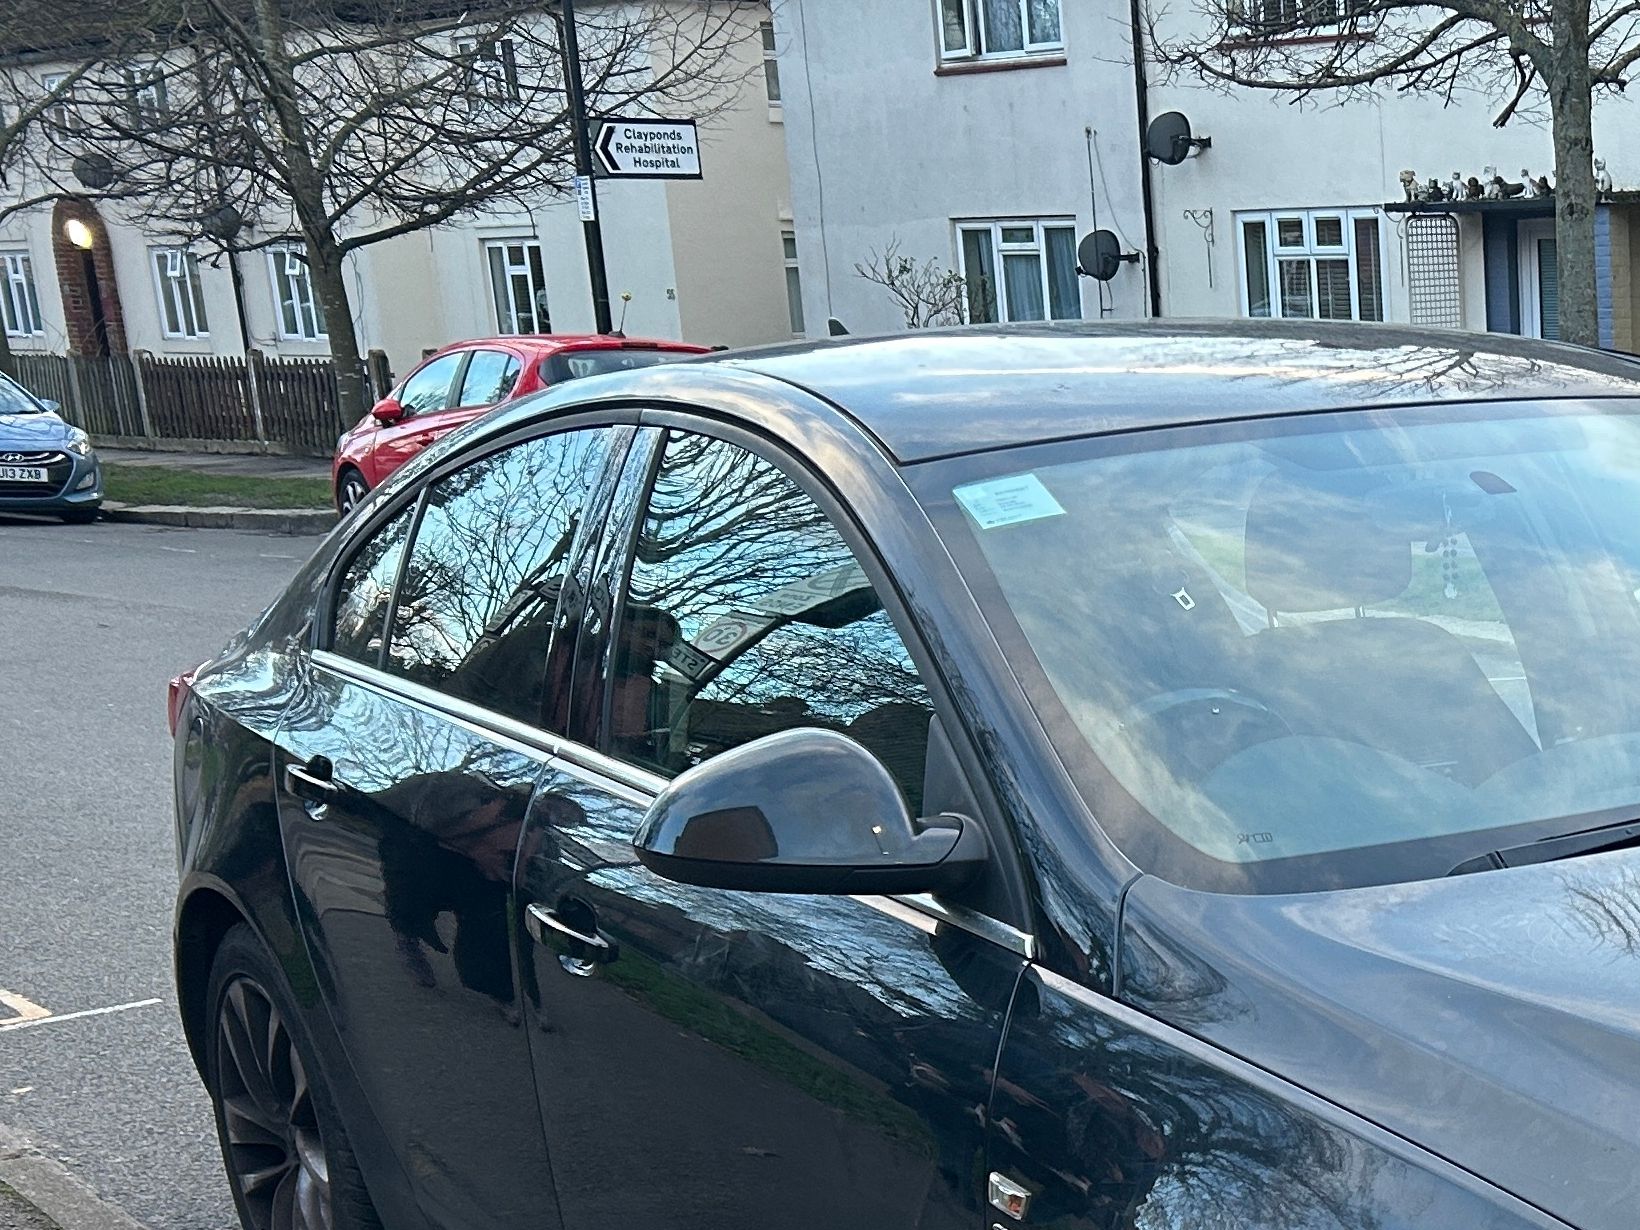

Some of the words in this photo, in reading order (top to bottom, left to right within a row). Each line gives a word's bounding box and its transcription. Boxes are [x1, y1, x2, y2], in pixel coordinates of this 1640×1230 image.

[624, 128, 682, 141] Clayponds
[616, 142, 693, 154] Rehabilitation
[634, 157, 681, 169] Hospital
